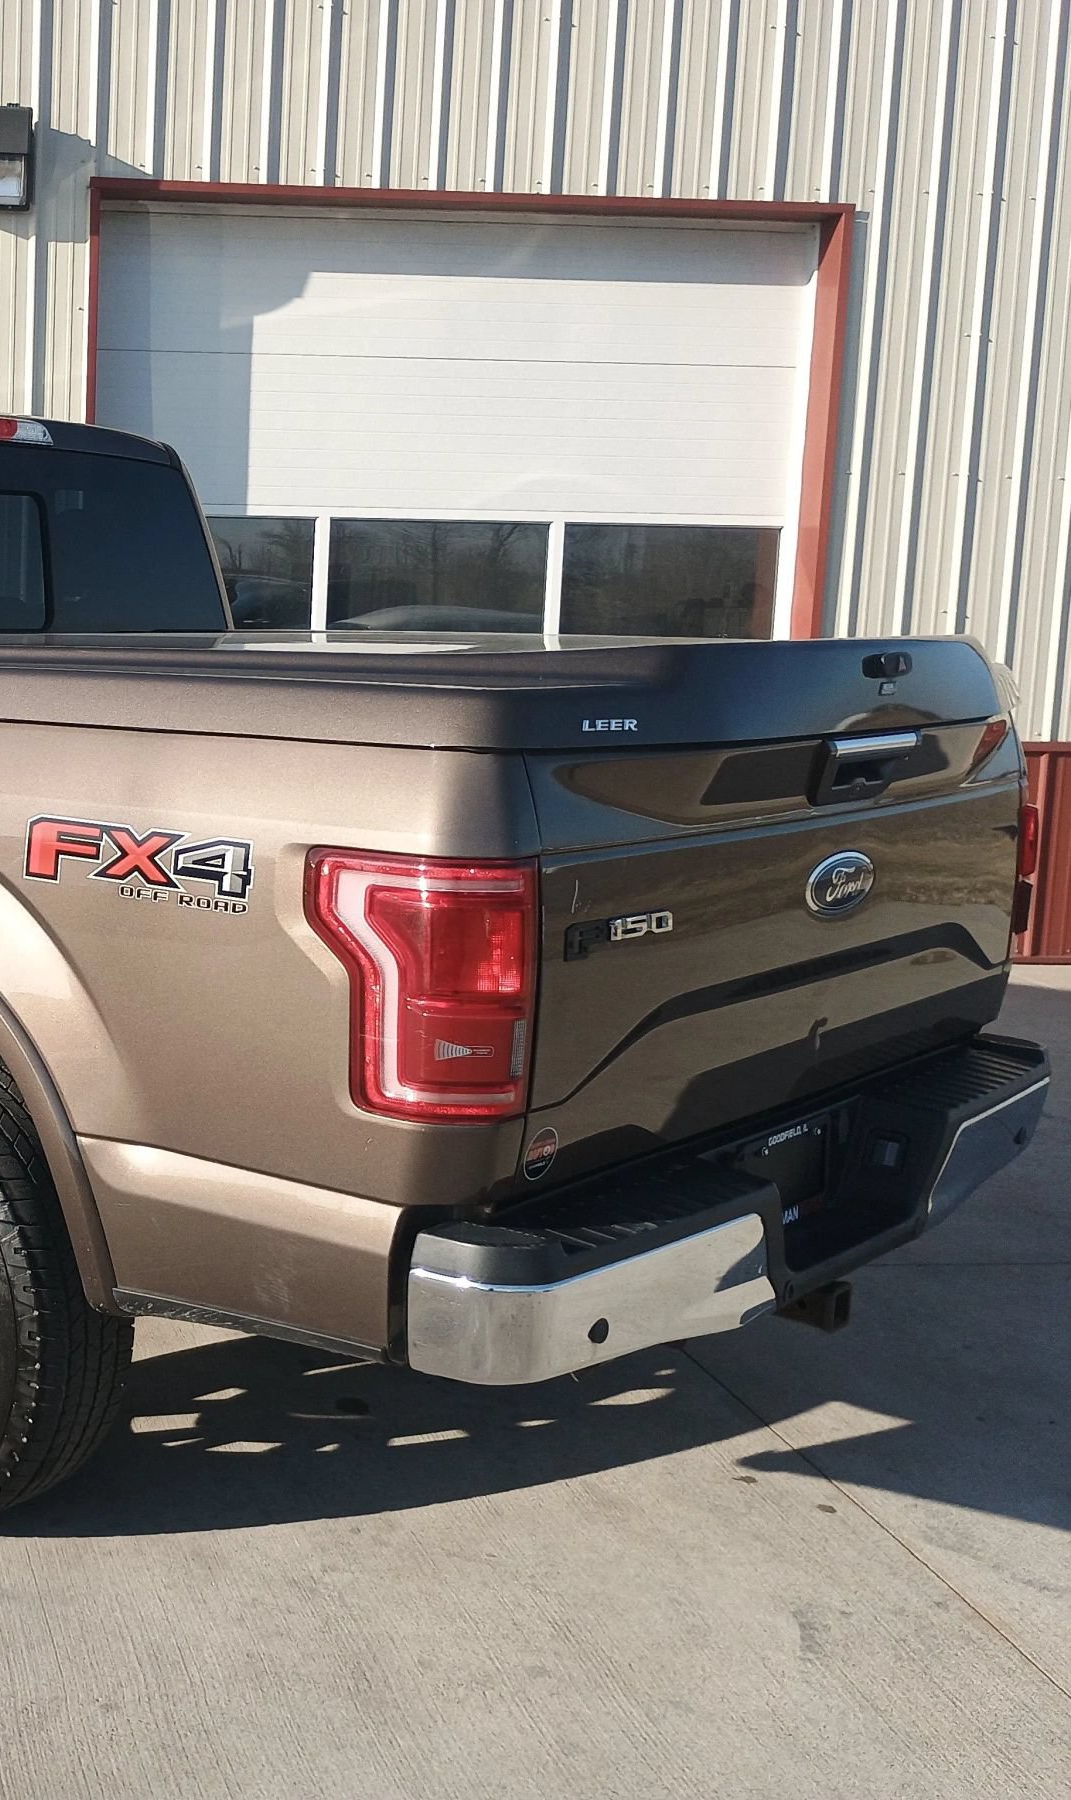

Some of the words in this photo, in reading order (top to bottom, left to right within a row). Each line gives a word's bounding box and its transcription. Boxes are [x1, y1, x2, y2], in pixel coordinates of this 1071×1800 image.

[581, 718, 638, 732] LEER
[23, 813, 255, 900] FX4
[118, 884, 169, 903] OFF
[177, 893, 249, 915] ROAD
[826, 866, 864, 902] Ford
